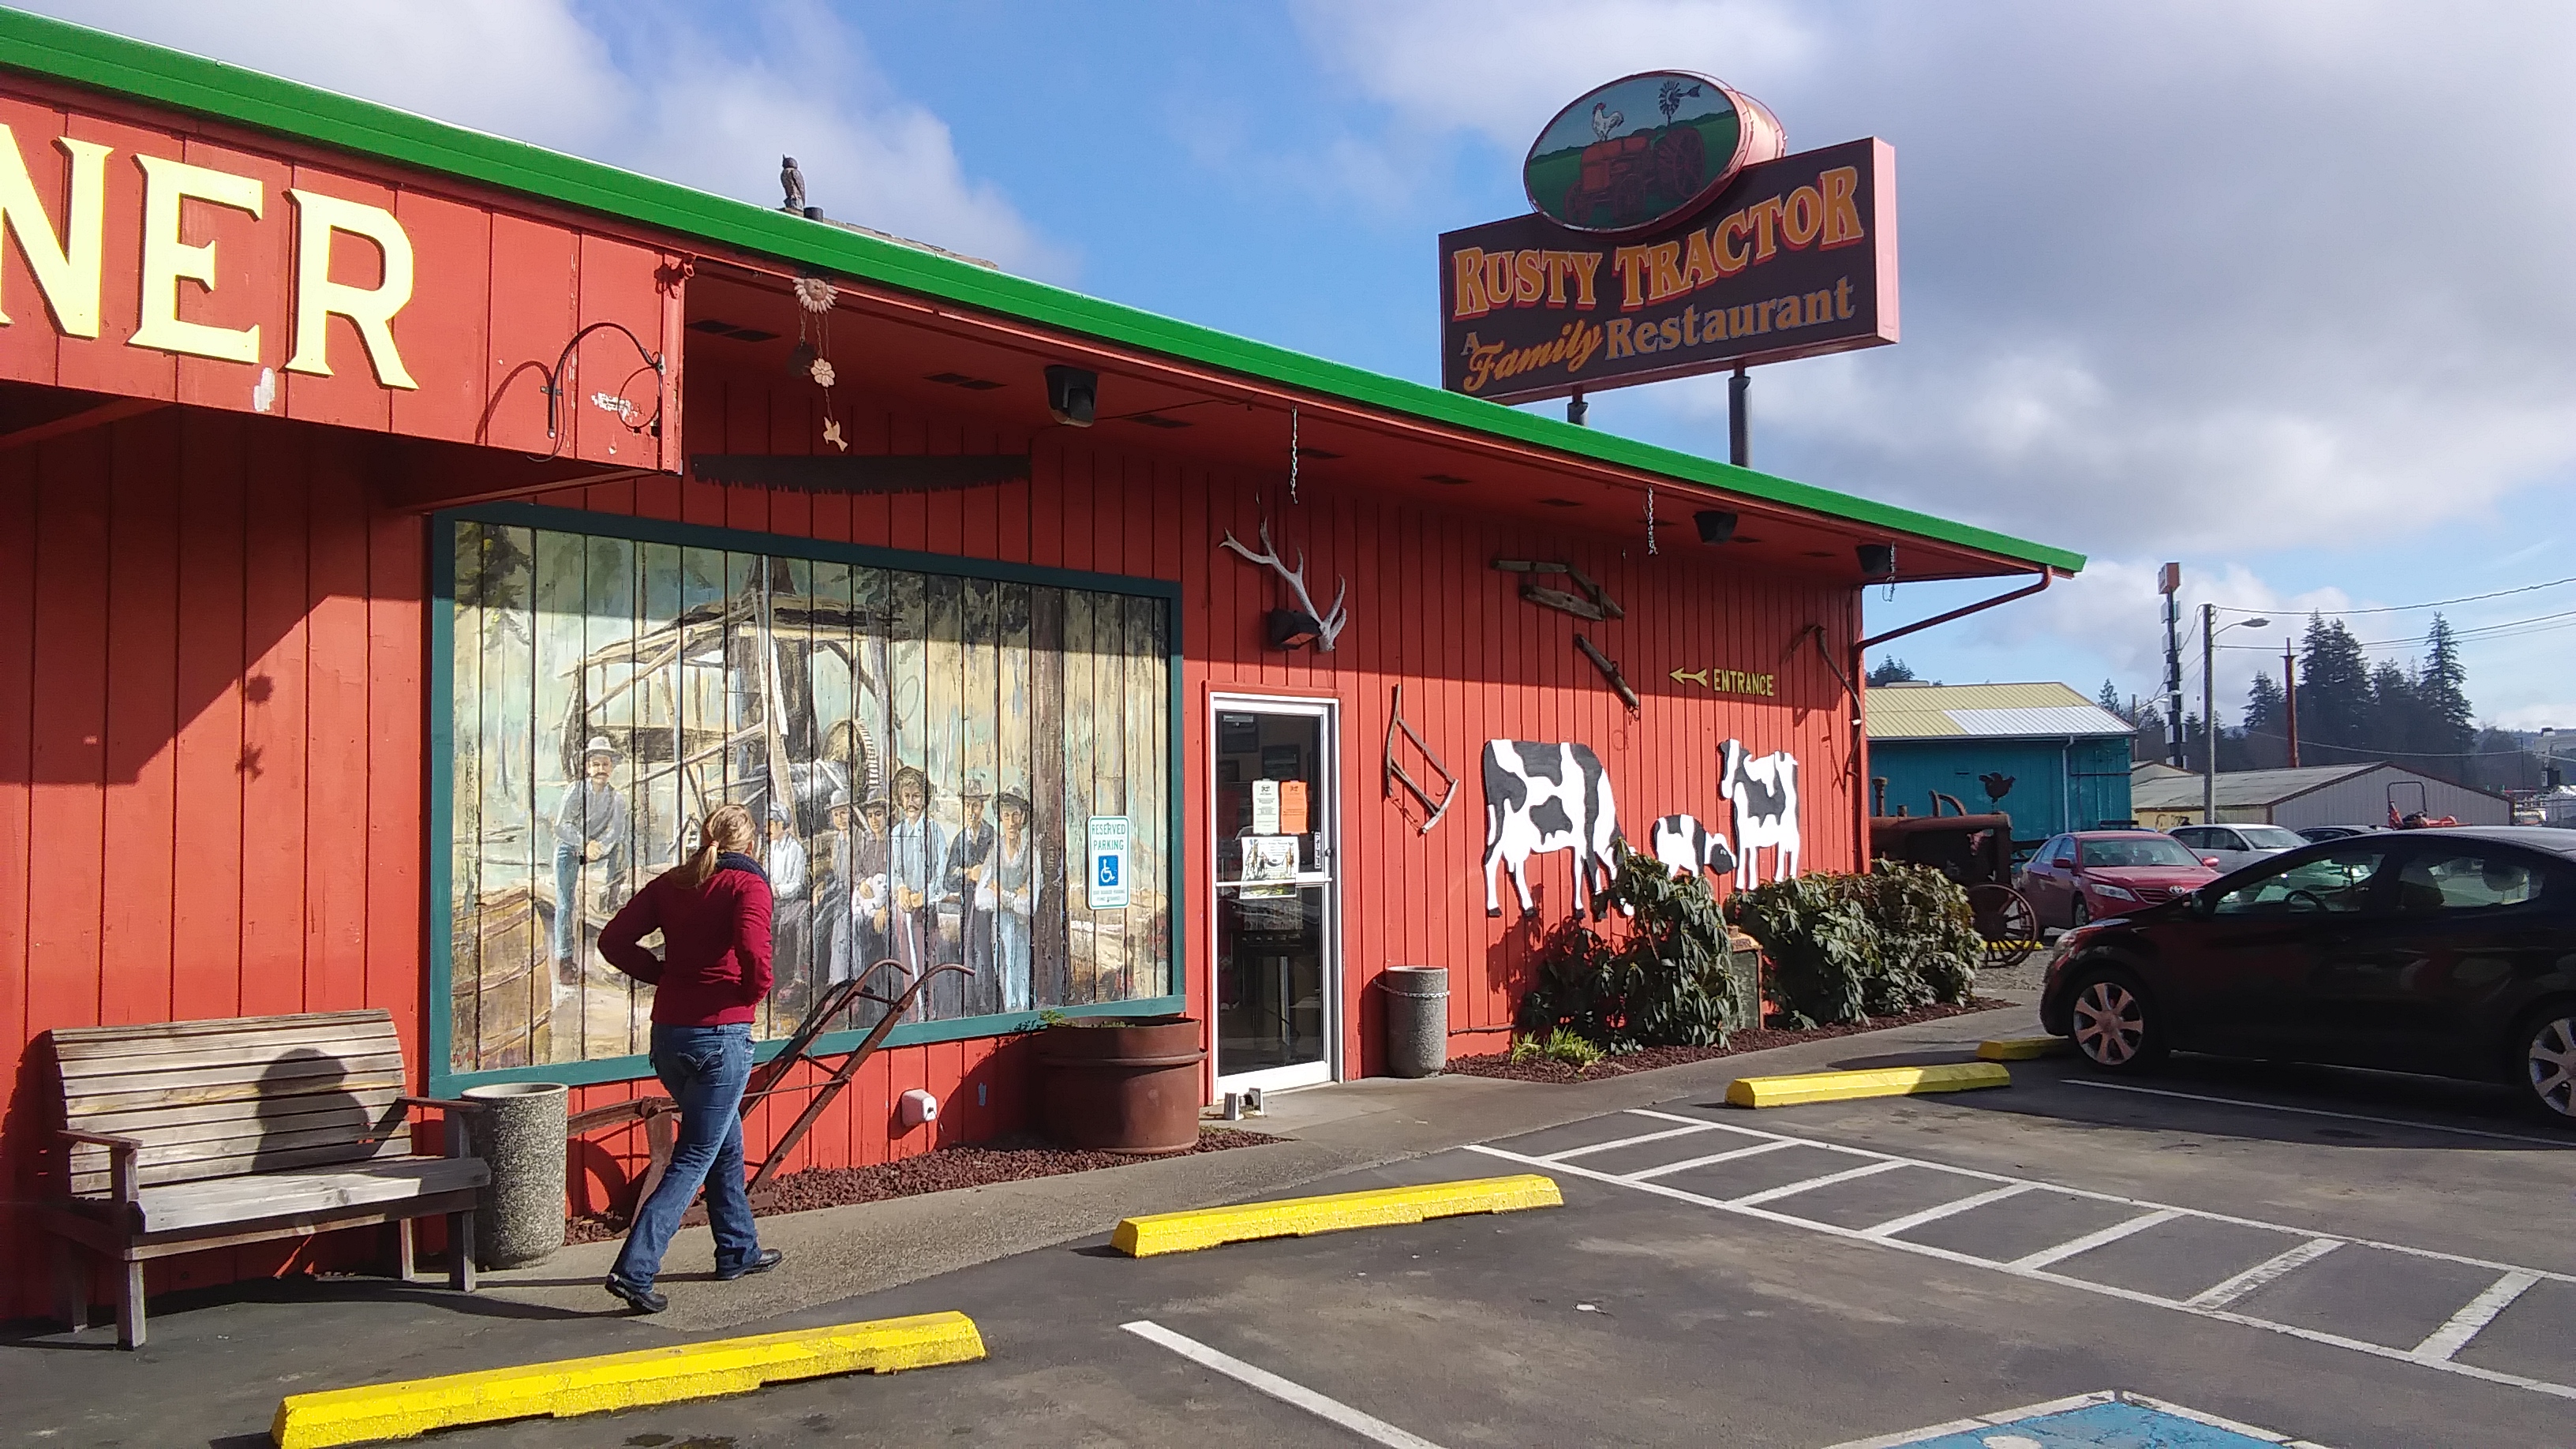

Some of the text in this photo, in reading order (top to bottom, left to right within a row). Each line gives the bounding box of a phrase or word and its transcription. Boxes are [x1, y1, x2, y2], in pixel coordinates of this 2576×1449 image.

[0, 122, 420, 391] NER
[1452, 165, 1865, 320] RUSTY TRACTOR
[1461, 275, 1856, 392] A Family Restaurant
[1713, 668, 1774, 696] ENTRANCE
[1091, 823, 1126, 835] RESERVED
[1093, 839, 1125, 851] PARKING
